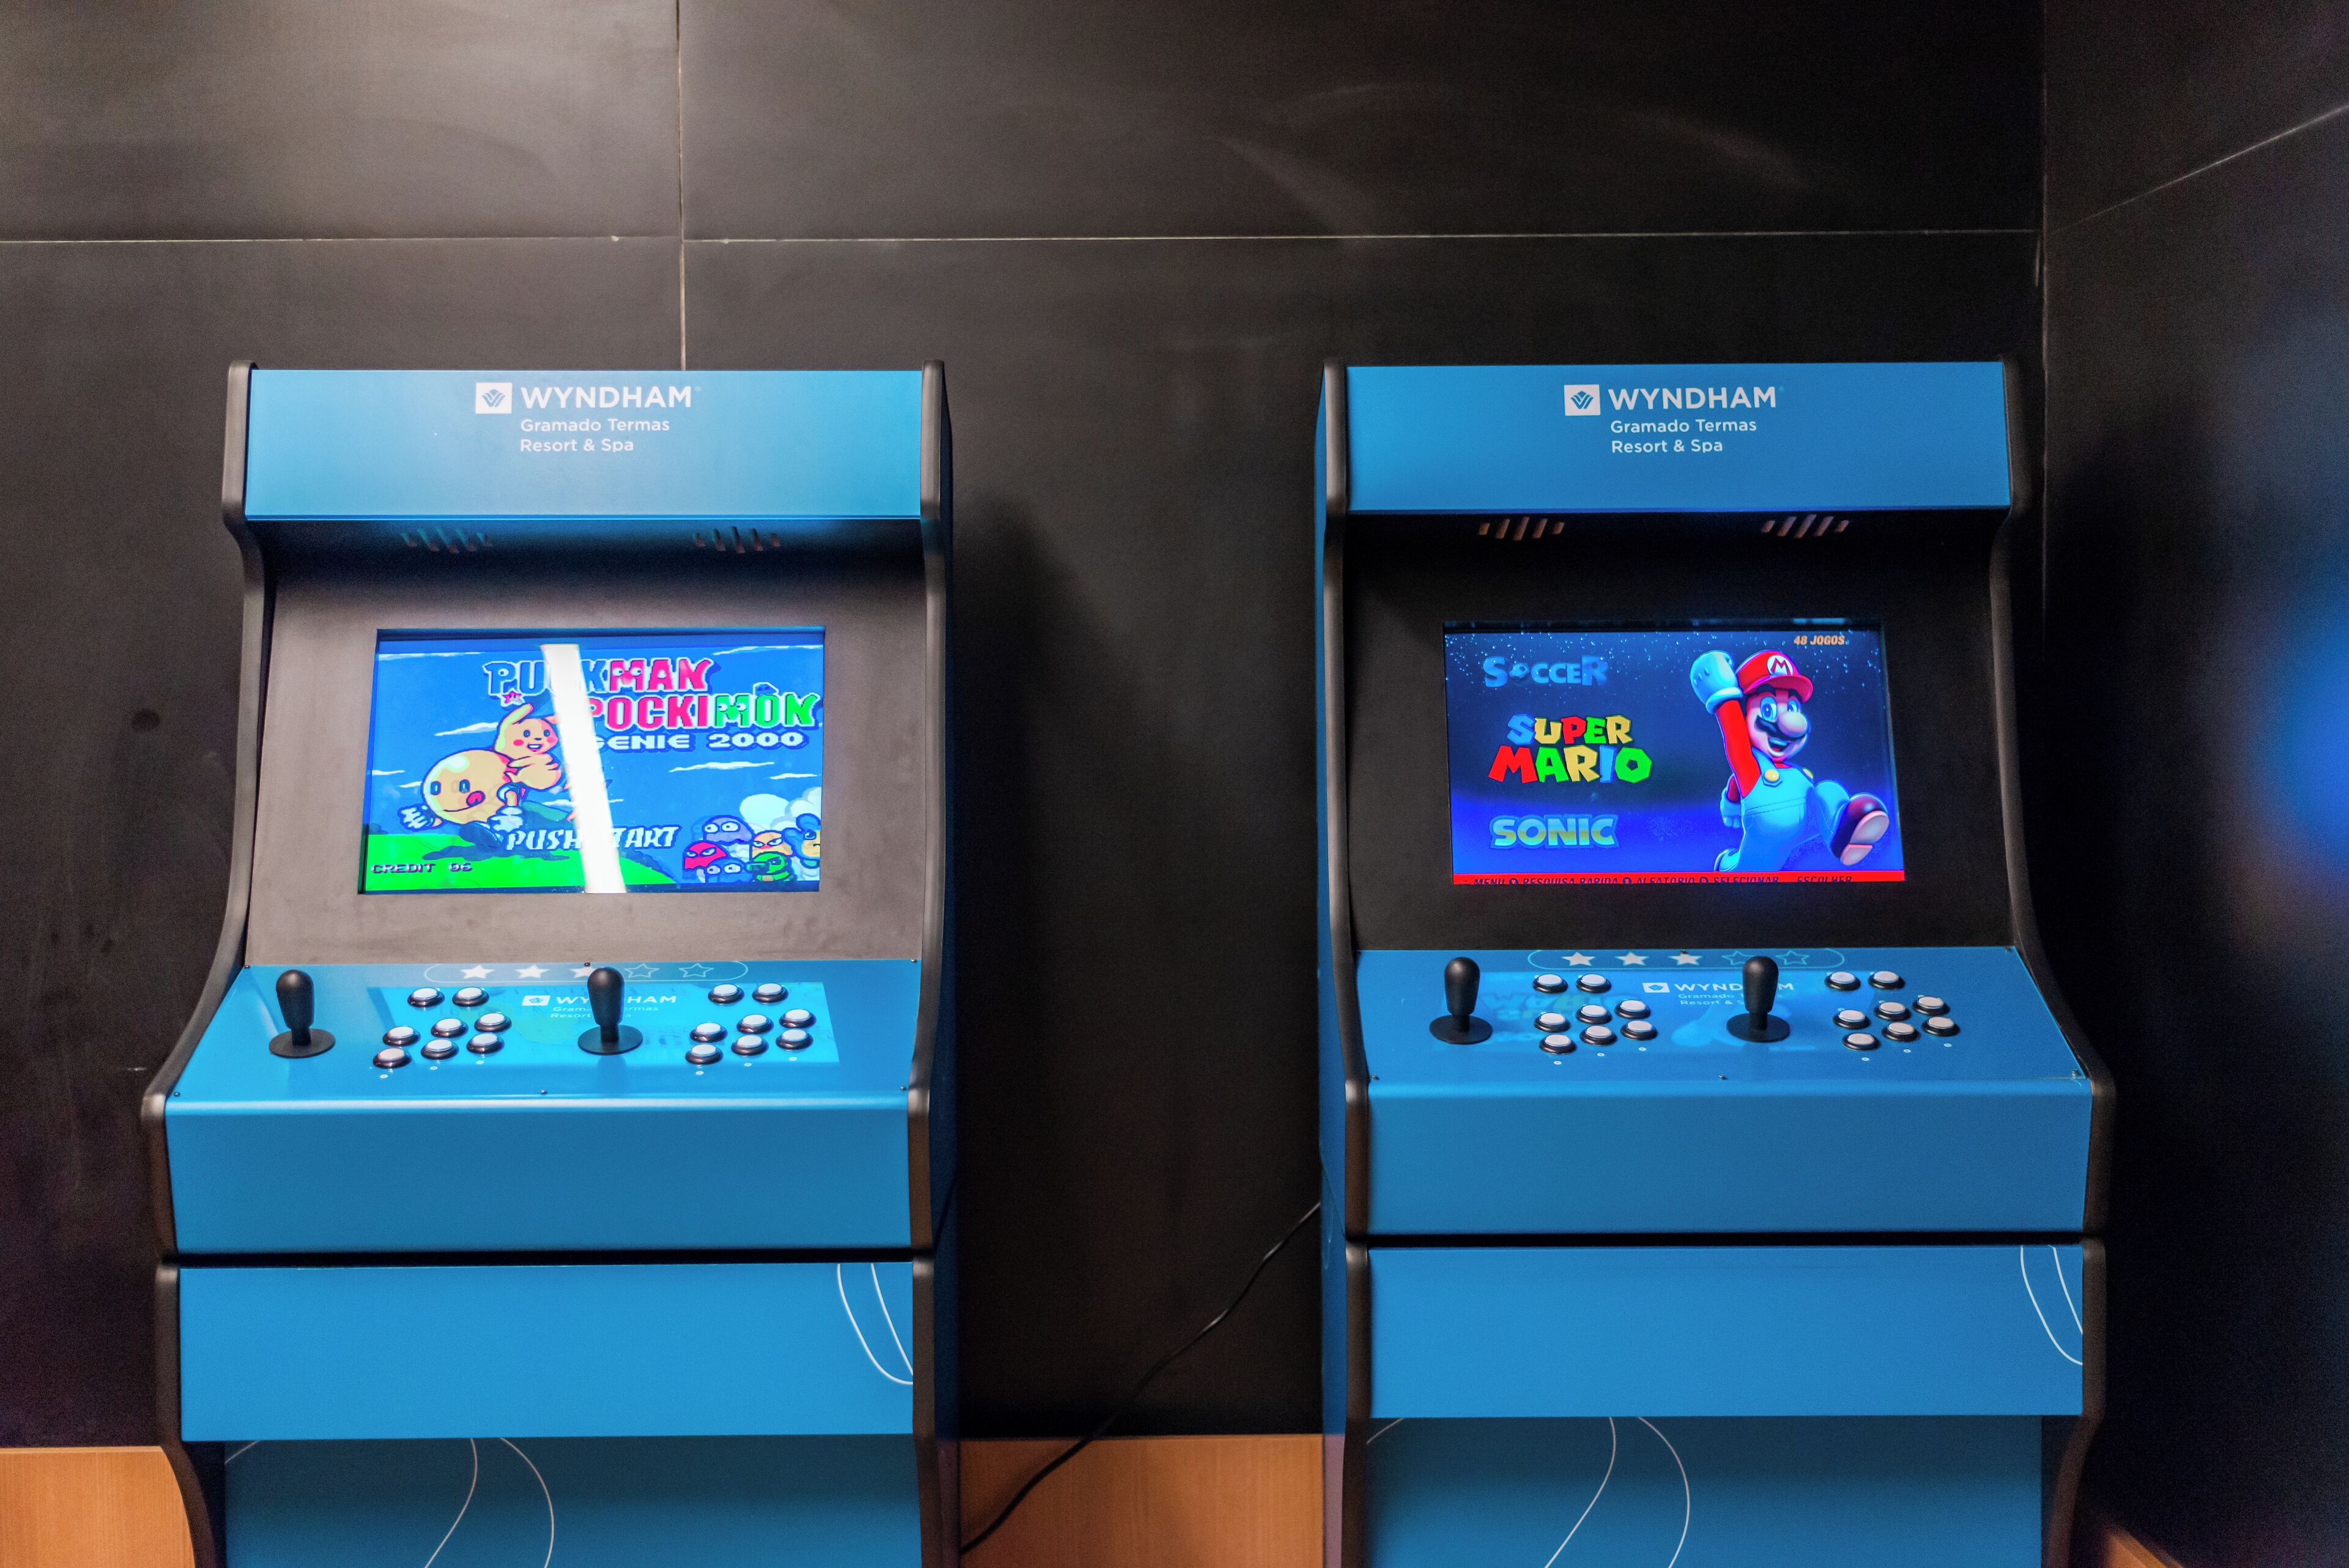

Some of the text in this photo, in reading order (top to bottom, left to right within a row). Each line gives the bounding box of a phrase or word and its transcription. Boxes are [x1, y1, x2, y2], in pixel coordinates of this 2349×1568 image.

[521, 386, 691, 409] WYNDHAM
[1608, 387, 1776, 410] WYNDHAM
[521, 418, 670, 432] Gramado Termas
[1611, 418, 1757, 434] Gramado Termas
[521, 438, 634, 453] Resort & Spa
[1611, 439, 1723, 453] Resort & Spa
[1794, 635, 1845, 645] 48 JOGOS
[483, 657, 714, 699] PUKMAN
[1507, 713, 1633, 746] SUPER
[708, 732, 805, 749] 2000
[1488, 745, 1652, 784] MARIO
[506, 826, 680, 851] PUSH TART
[1491, 815, 1618, 848] SONIC
[371, 863, 436, 874] CREDIT
[1674, 983, 1794, 991] WYNDM
[556, 995, 677, 1004] WYHAM
